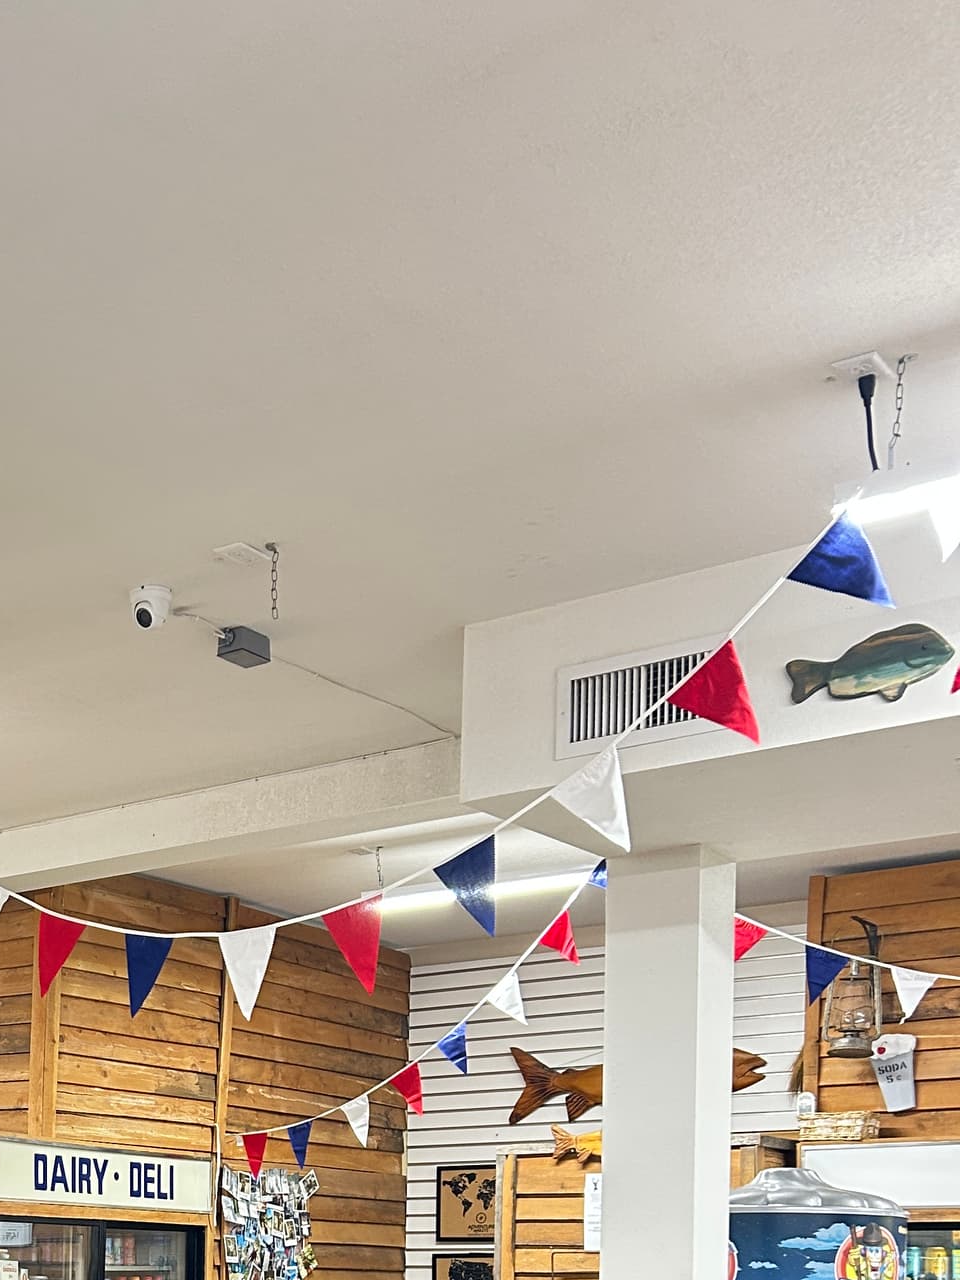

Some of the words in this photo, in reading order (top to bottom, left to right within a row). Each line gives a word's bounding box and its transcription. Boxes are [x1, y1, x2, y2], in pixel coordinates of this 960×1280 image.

[878, 1061, 908, 1075] SODA
[33, 1152, 109, 1195] DAIRY
[129, 1161, 175, 1200] DELI
